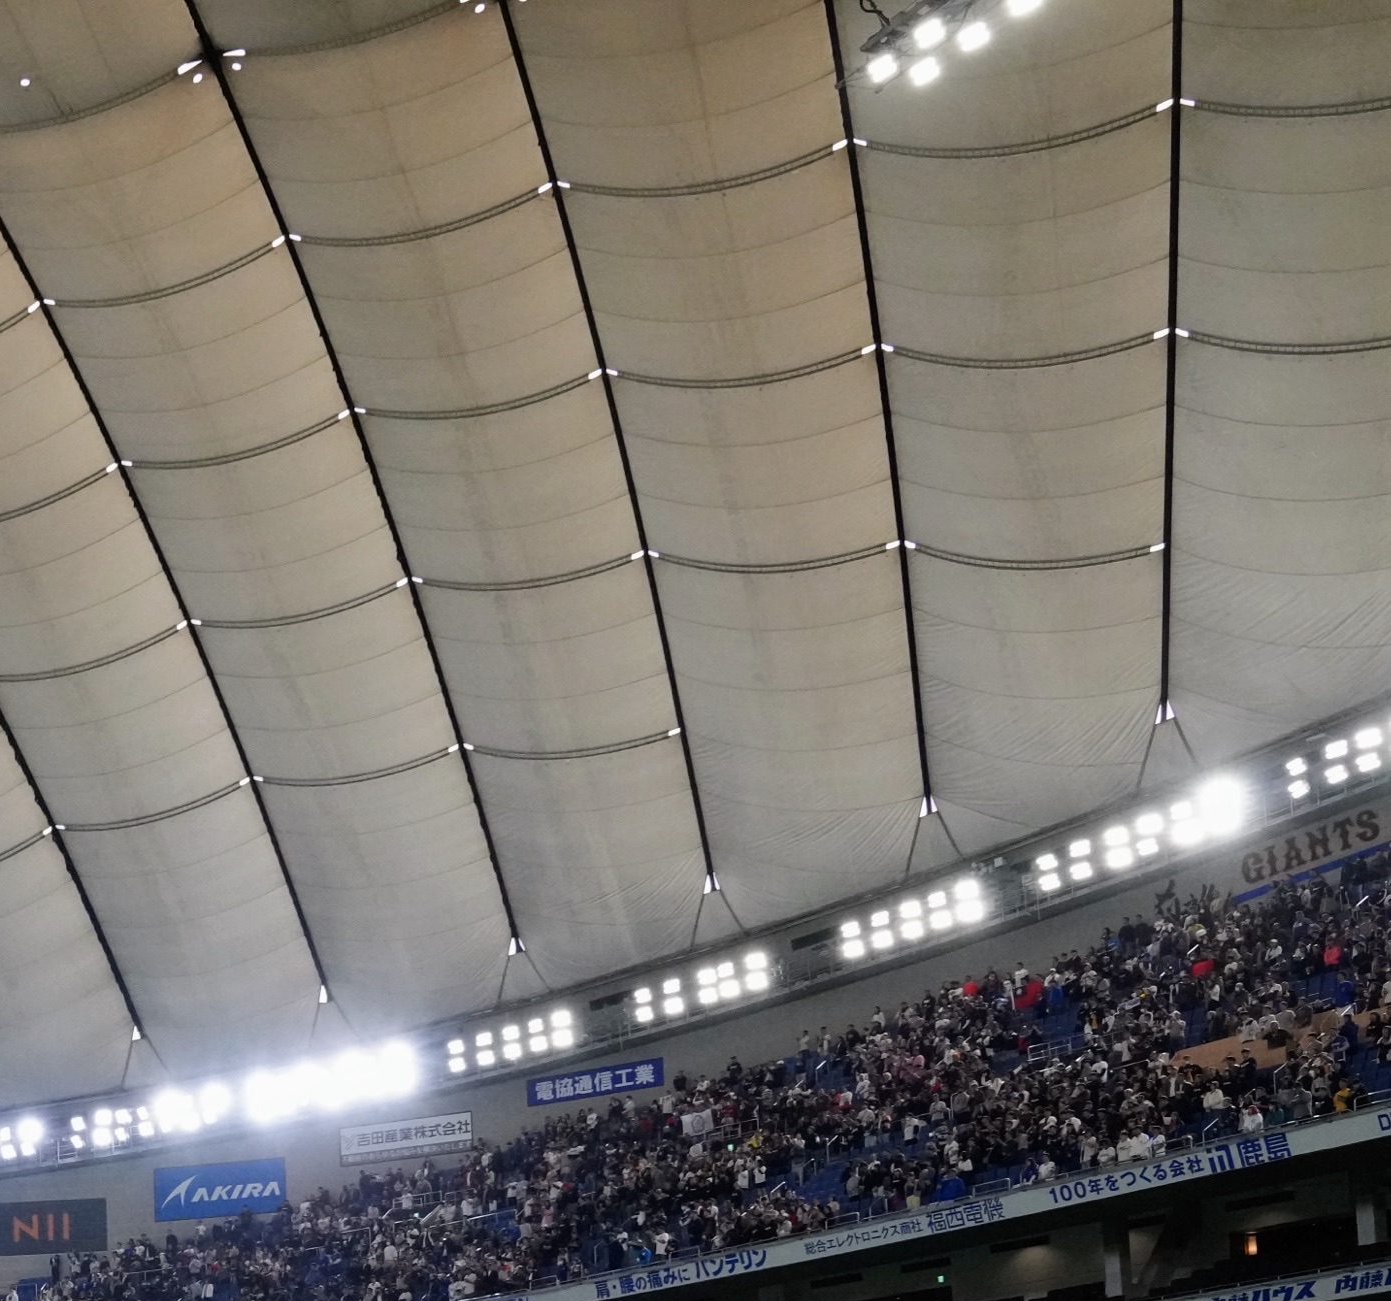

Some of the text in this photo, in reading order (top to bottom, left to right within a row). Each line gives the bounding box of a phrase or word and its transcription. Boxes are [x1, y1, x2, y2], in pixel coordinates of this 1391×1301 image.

[1241, 809, 1381, 885] GIANTS
[535, 1064, 655, 1101] 電協通信工業
[357, 1119, 471, 1147] 吉田産業株式会社
[1049, 1132, 1292, 1204] 100年をつくる会社 鹿島
[192, 1180, 281, 1204] AKIRA
[926, 1197, 1005, 1234] 福西電機
[594, 1249, 767, 1299] 肩・腰の痛みに バンテリン
